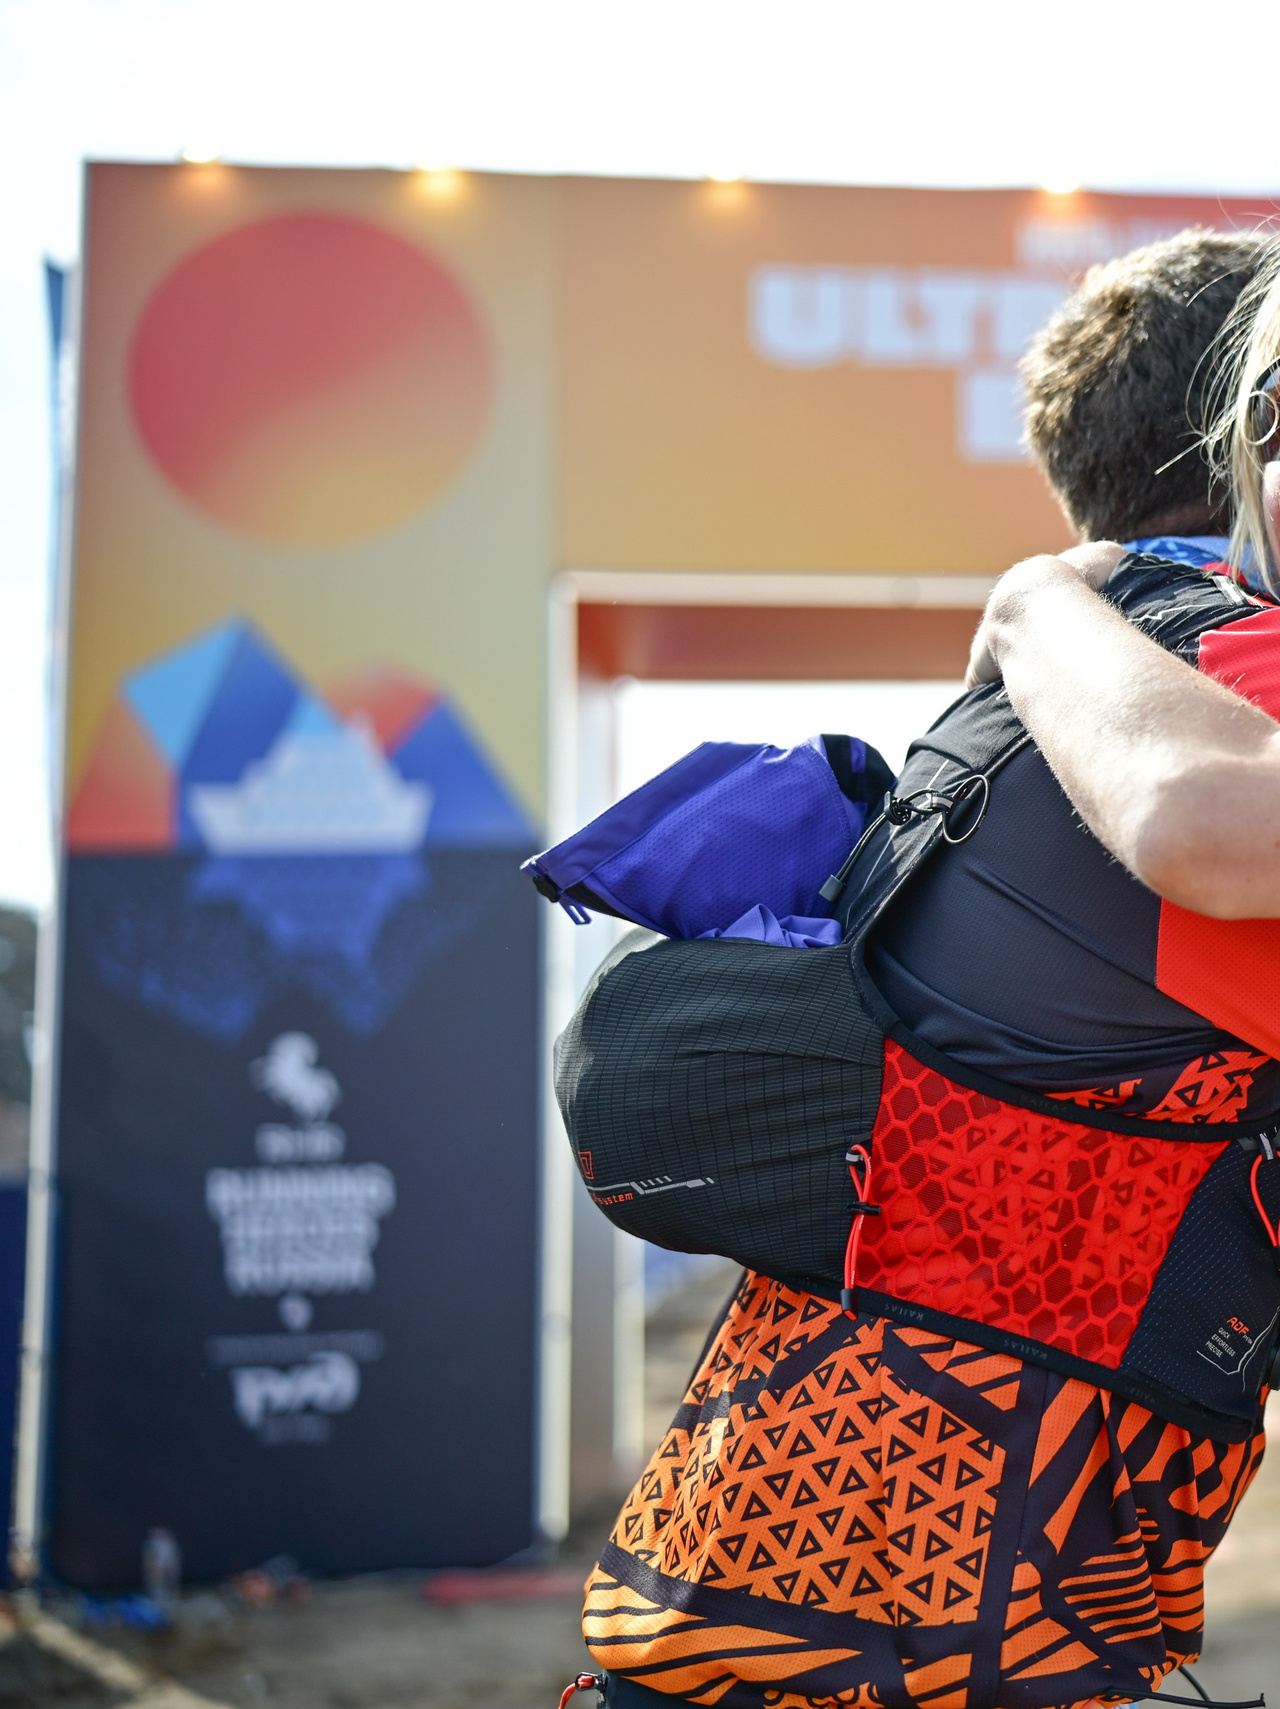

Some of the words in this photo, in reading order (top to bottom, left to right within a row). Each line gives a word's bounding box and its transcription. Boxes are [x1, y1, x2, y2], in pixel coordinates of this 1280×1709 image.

[1218, 1327, 1230, 1339] QUICK
[1227, 1316, 1250, 1334] ADF
[1205, 1340, 1223, 1357] PRECISE
[1211, 1333, 1235, 1357] EFFORTLESS
